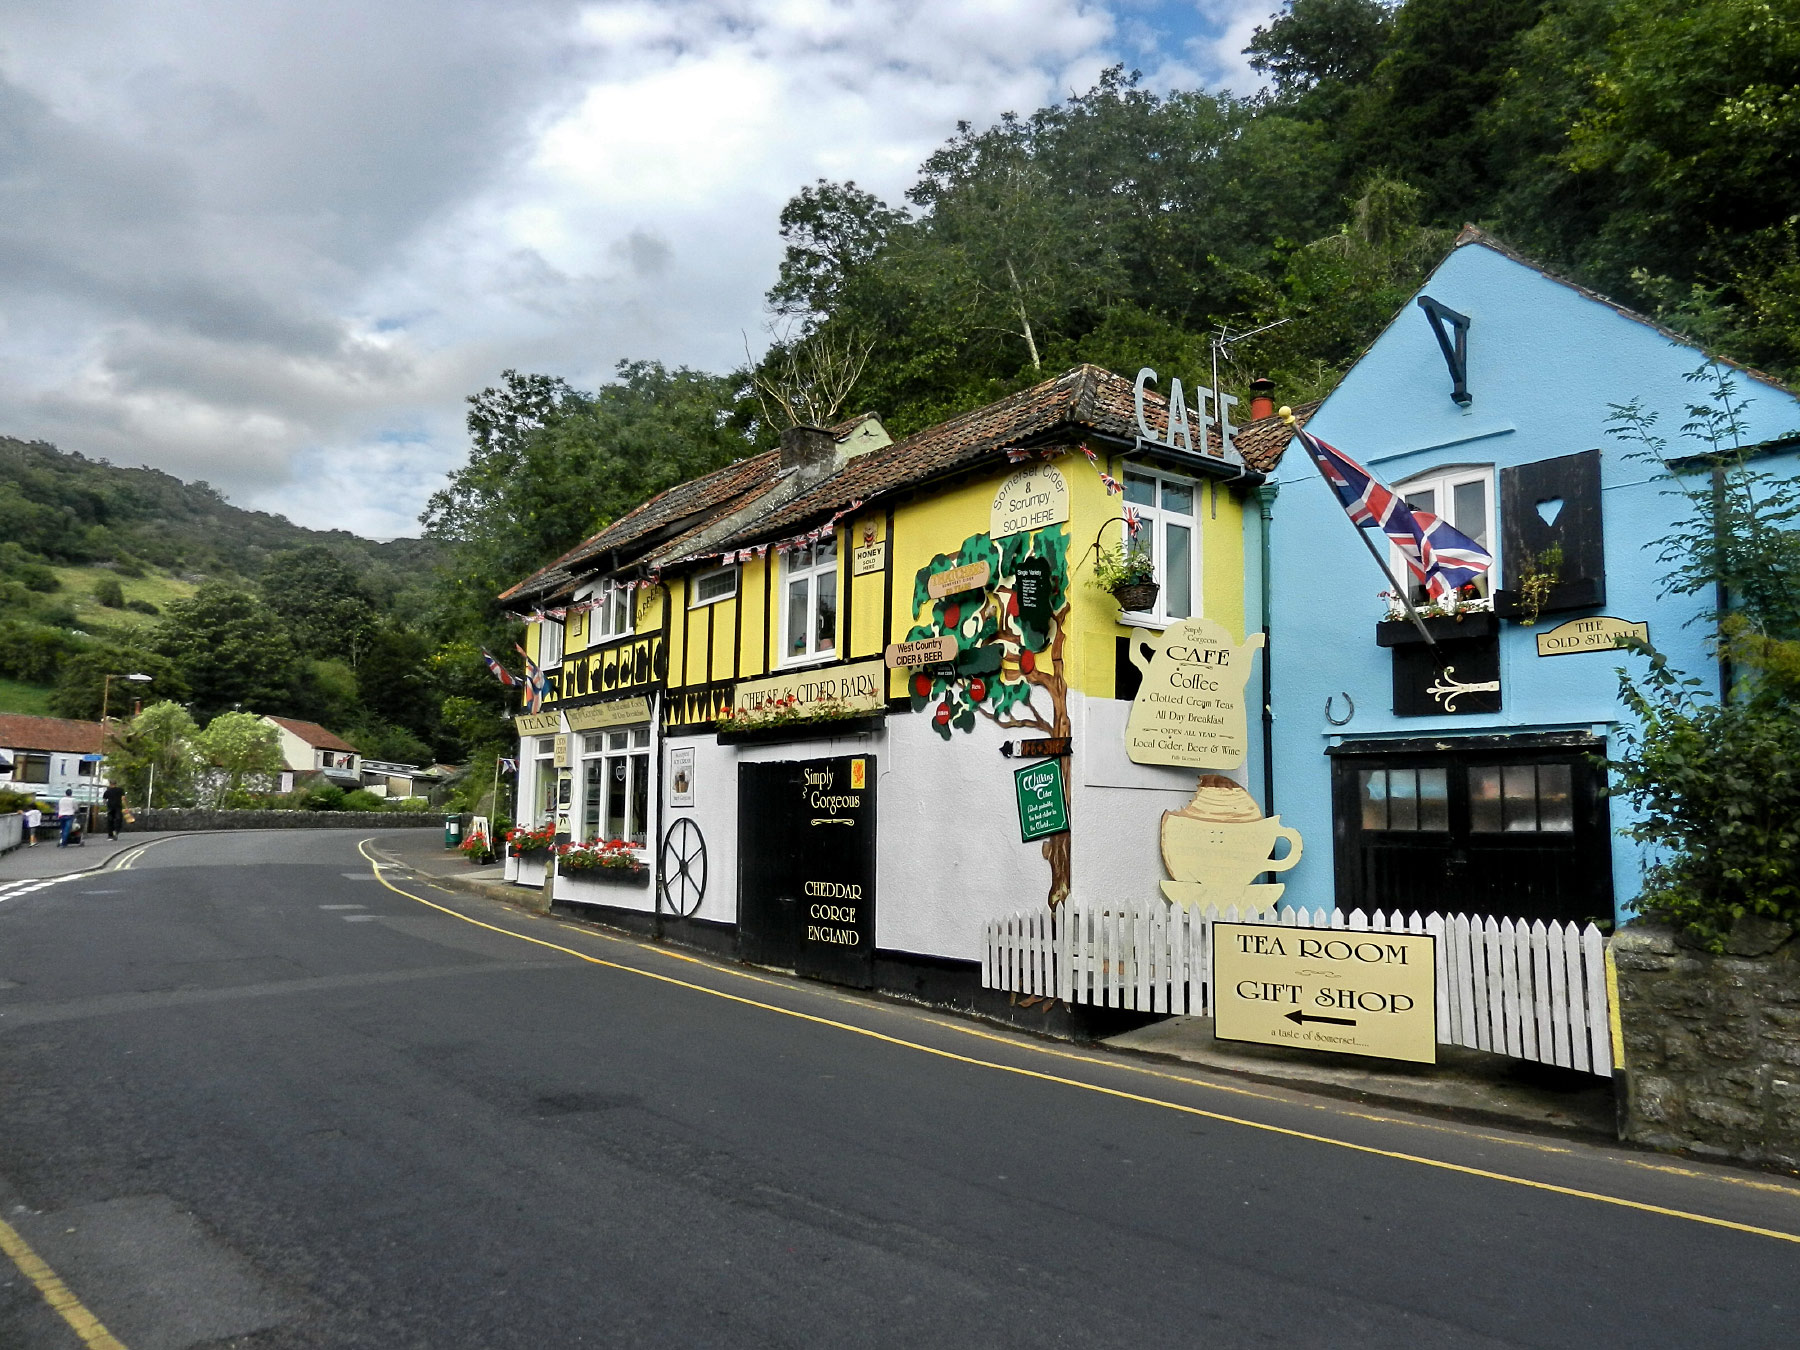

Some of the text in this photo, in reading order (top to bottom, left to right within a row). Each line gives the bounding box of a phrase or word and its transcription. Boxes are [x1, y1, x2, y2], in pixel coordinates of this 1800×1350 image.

[1134, 367, 1240, 464] CAFE
[994, 464, 1064, 510] Somerset Cider
[1009, 492, 1050, 512] Scrumpy
[1004, 508, 1054, 532] SOLD HERE
[857, 548, 882, 560] HONEY
[1184, 625, 1203, 636] Simply
[1576, 620, 1604, 633] THE
[898, 639, 943, 654] West Country
[1187, 635, 1218, 645] Gorgeous
[1547, 636, 1580, 649] OLD
[896, 651, 943, 666] CIDER & BEER
[1166, 646, 1230, 666] CAFÉ
[797, 680, 836, 704] CIDER
[841, 674, 875, 698] BARN
[1170, 672, 1219, 692] Coffee
[1150, 693, 1234, 710] Clotted Cream Teas
[520, 718, 544, 730] TEA
[1156, 710, 1224, 725] All Day Breakfast
[1133, 738, 1155, 748] Local
[1188, 743, 1207, 753] Beer
[1211, 745, 1219, 754] &
[1222, 745, 1240, 756] Wine
[804, 766, 834, 790] Simply
[1023, 771, 1054, 791] Wilkins
[811, 791, 860, 815] Gorgeous
[1037, 788, 1052, 800] Cider
[804, 881, 862, 900] CHEDDAR
[810, 904, 856, 923] GORGE
[808, 925, 859, 946] ENGLAND
[1237, 934, 1408, 965] TEA ROOM
[1236, 980, 1414, 1013] GIFT SHOP
[1278, 1028, 1300, 1039] taste
[1303, 1030, 1313, 1040] of
